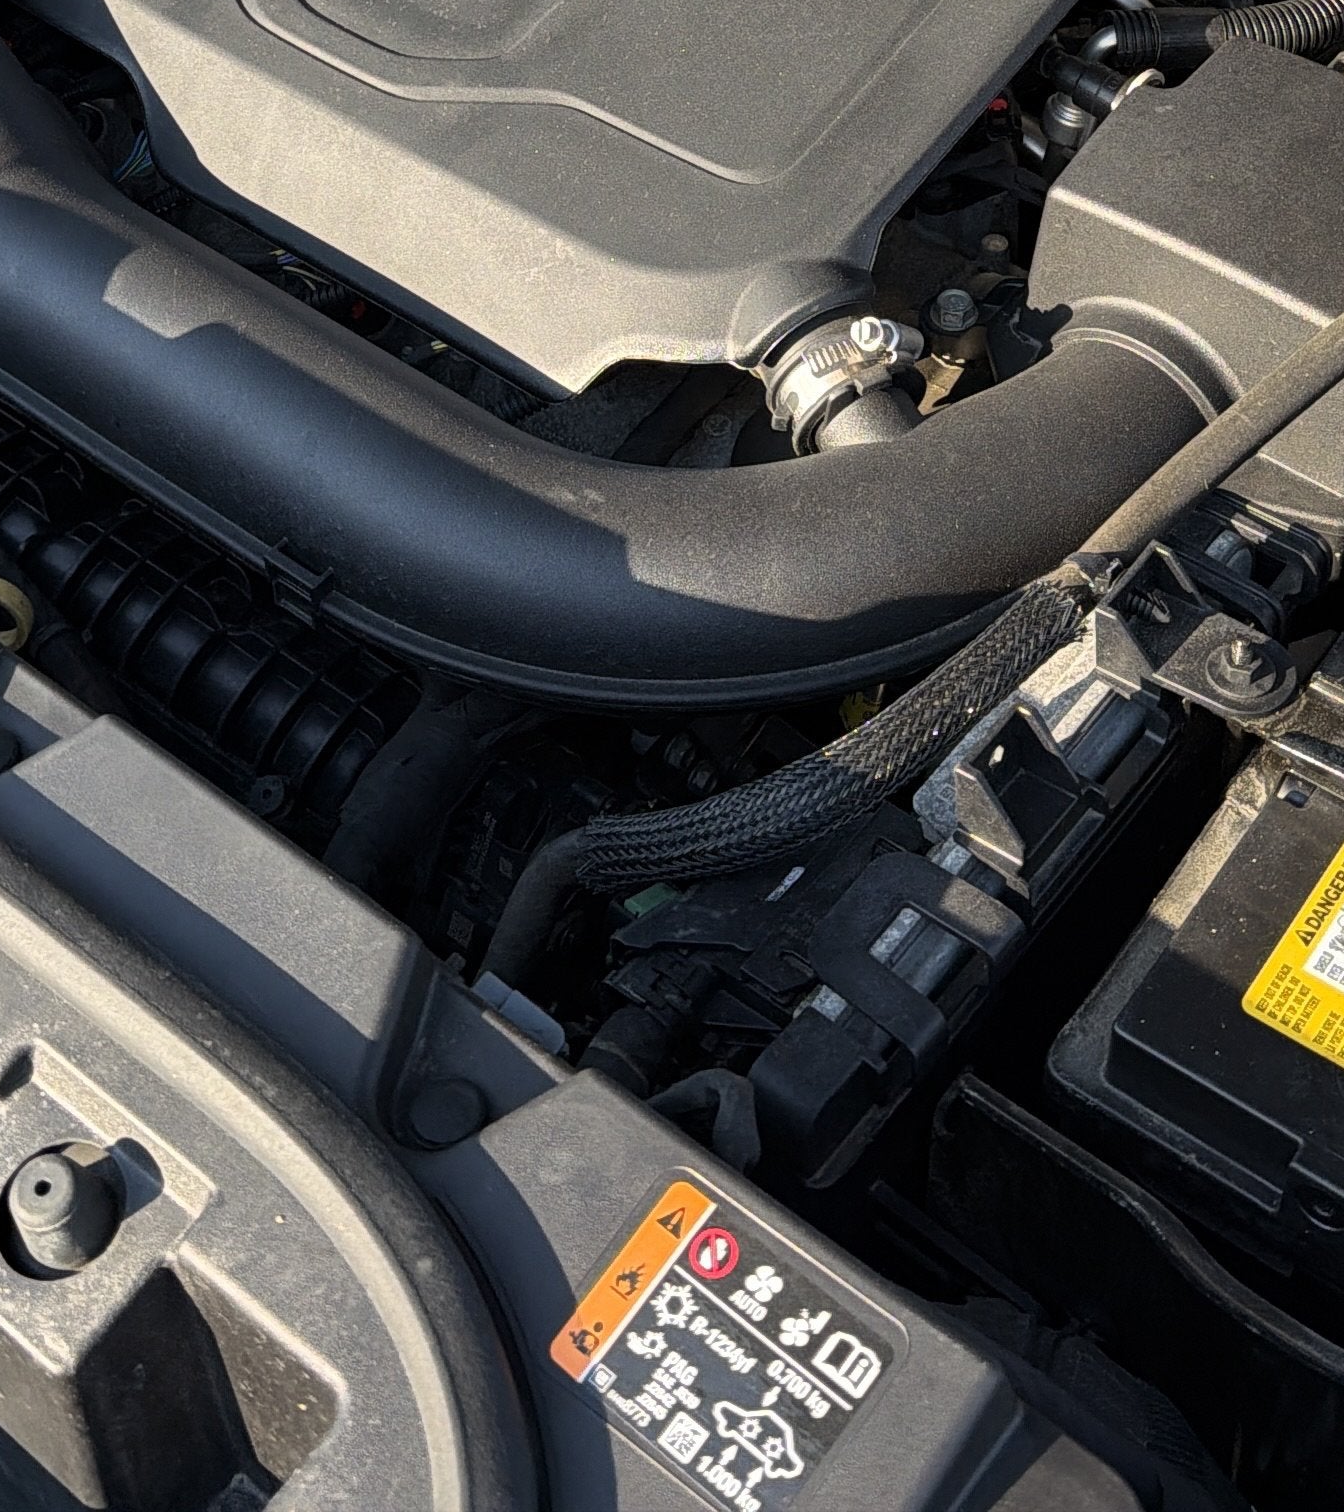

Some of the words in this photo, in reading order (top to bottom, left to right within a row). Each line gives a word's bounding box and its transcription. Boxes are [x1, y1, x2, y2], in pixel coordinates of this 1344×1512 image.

[728, 1290, 768, 1322] AUTO
[660, 1351, 698, 1383] PAG
[763, 1357, 812, 1401] 0.700
[803, 1390, 833, 1418] kg
[695, 1455, 742, 1498] 1.000
[733, 1488, 762, 1512] kg
